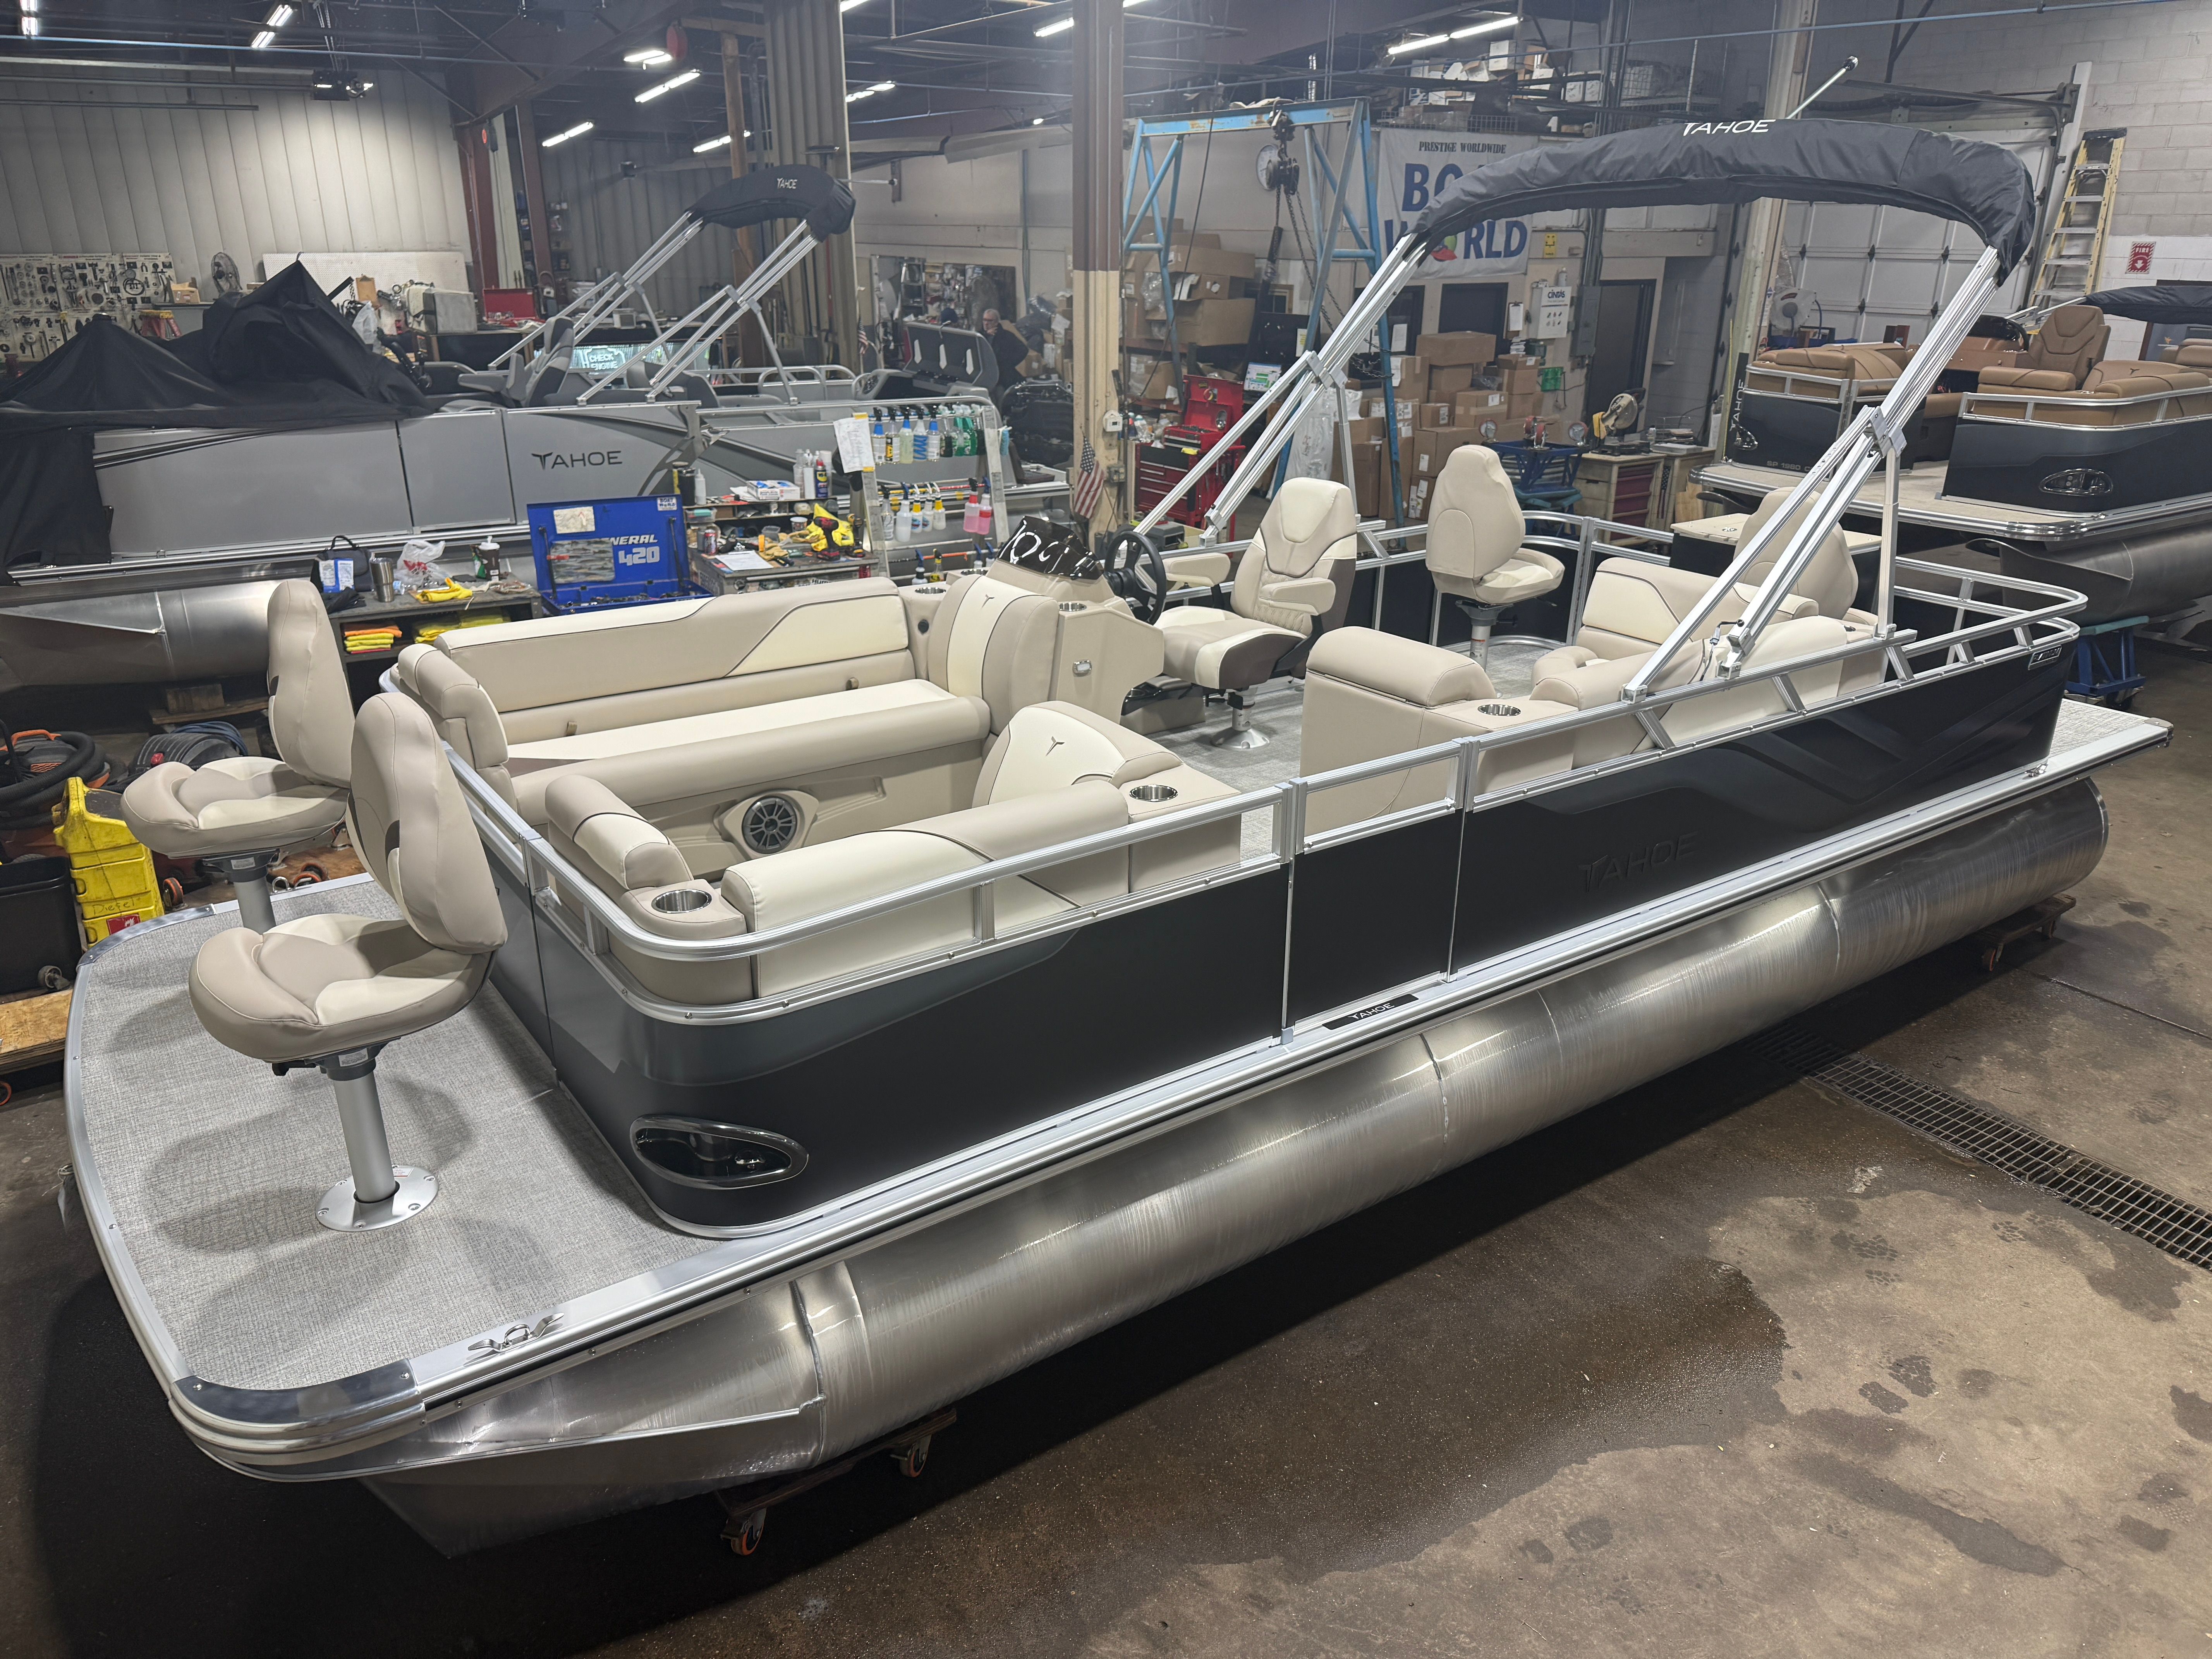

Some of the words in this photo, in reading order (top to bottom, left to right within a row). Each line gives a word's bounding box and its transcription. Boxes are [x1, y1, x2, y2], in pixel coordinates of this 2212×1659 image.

[1683, 119, 1776, 136] TAHOE
[1419, 141, 1456, 152] PRESTIGE
[1460, 143, 1506, 154] WORLDWIDE
[777, 178, 798, 189] TAHOE
[1548, 289, 1565, 299] CINTAS
[589, 353, 614, 362] CHECK
[1729, 379, 1743, 431] TAHOE
[531, 451, 622, 470] TAHOE
[618, 546, 660, 566] 420
[1578, 831, 1698, 893] TAHOE
[92, 897, 134, 915] Diesel
[1348, 1003, 1395, 1019] TAHOE
